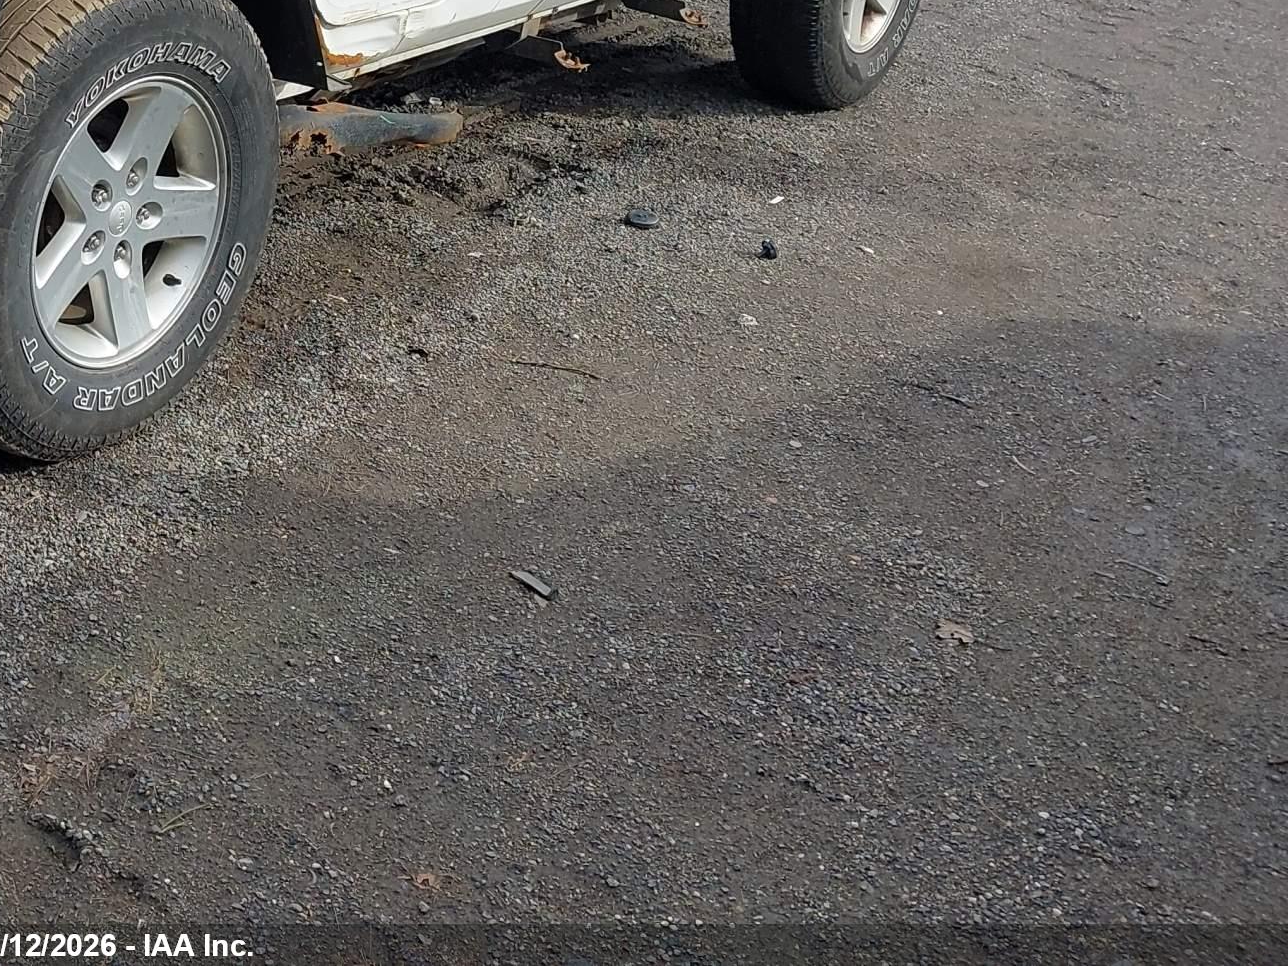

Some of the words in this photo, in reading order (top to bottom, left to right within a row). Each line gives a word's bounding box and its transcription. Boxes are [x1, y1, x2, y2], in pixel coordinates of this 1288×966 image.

[65, 42, 232, 129] YOKOHAMA
[21, 336, 67, 395] A/T
[73, 242, 247, 412] GEOLANDAR
